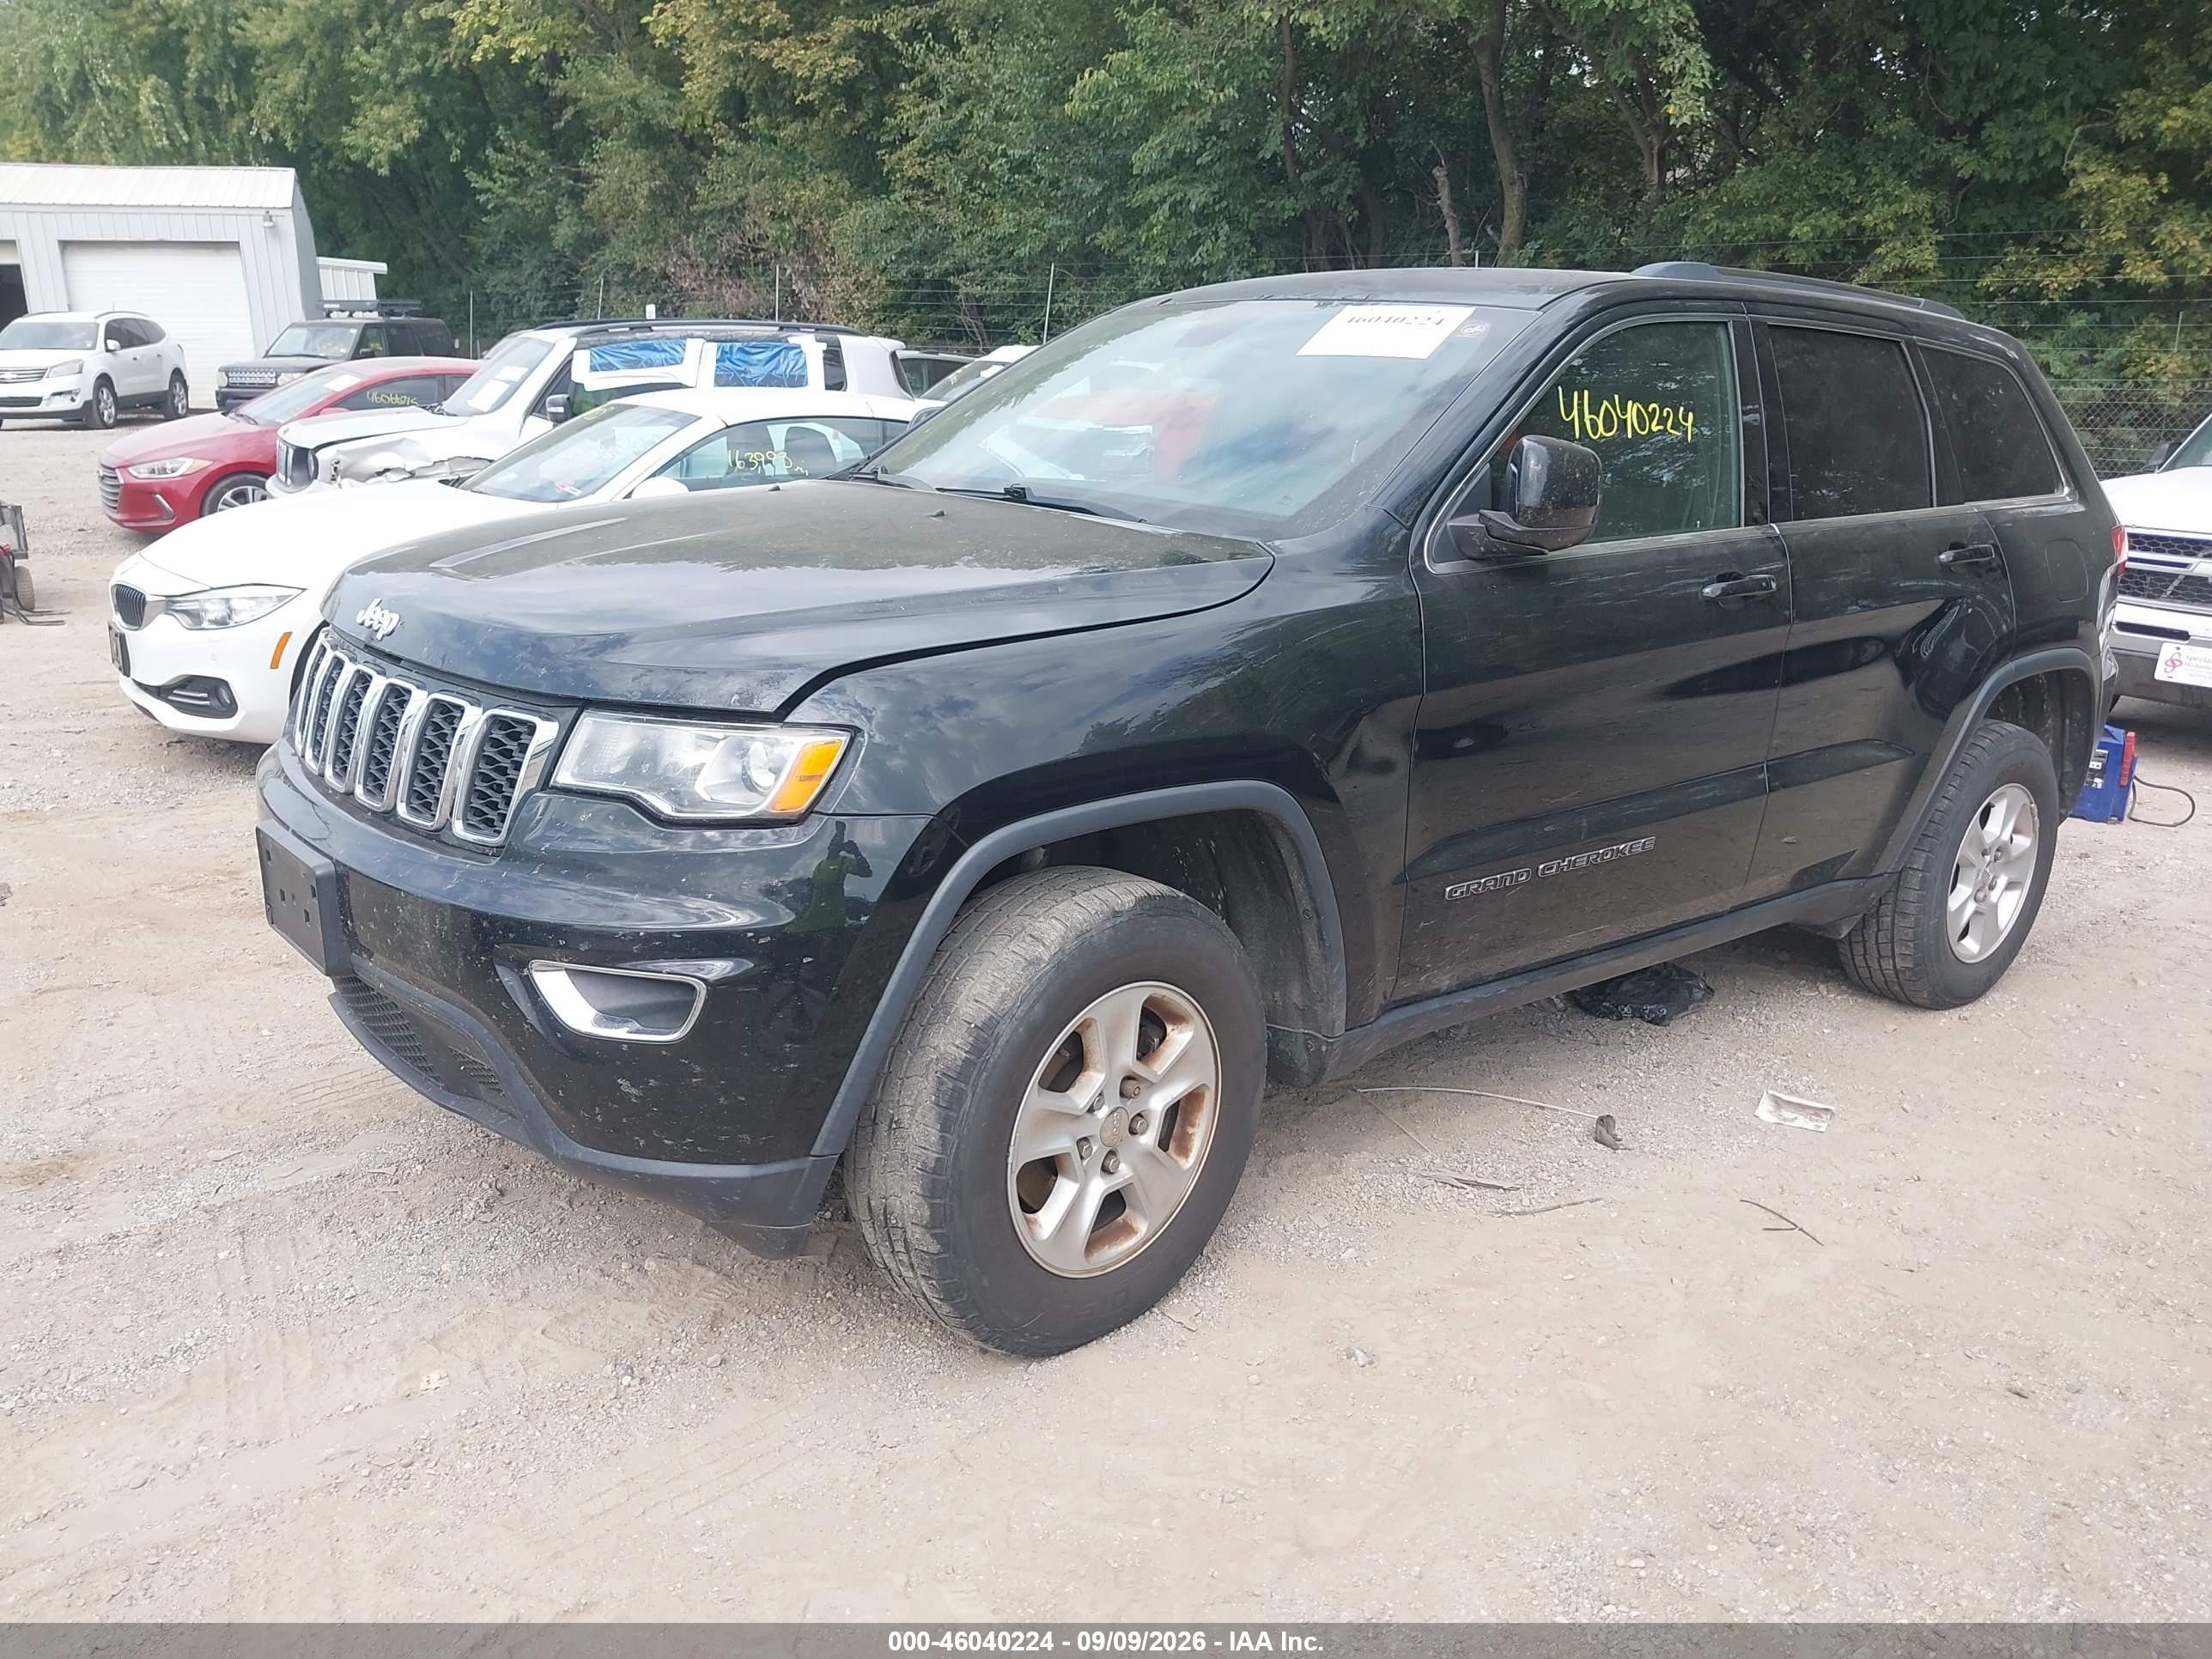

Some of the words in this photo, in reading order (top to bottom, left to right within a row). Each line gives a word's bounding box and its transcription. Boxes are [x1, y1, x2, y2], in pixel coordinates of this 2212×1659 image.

[1558, 385, 1695, 443] 46040224
[356, 598, 400, 641] Jeep
[1444, 867, 1533, 901] GRAND
[1537, 836, 1656, 878] CHEROKEE
